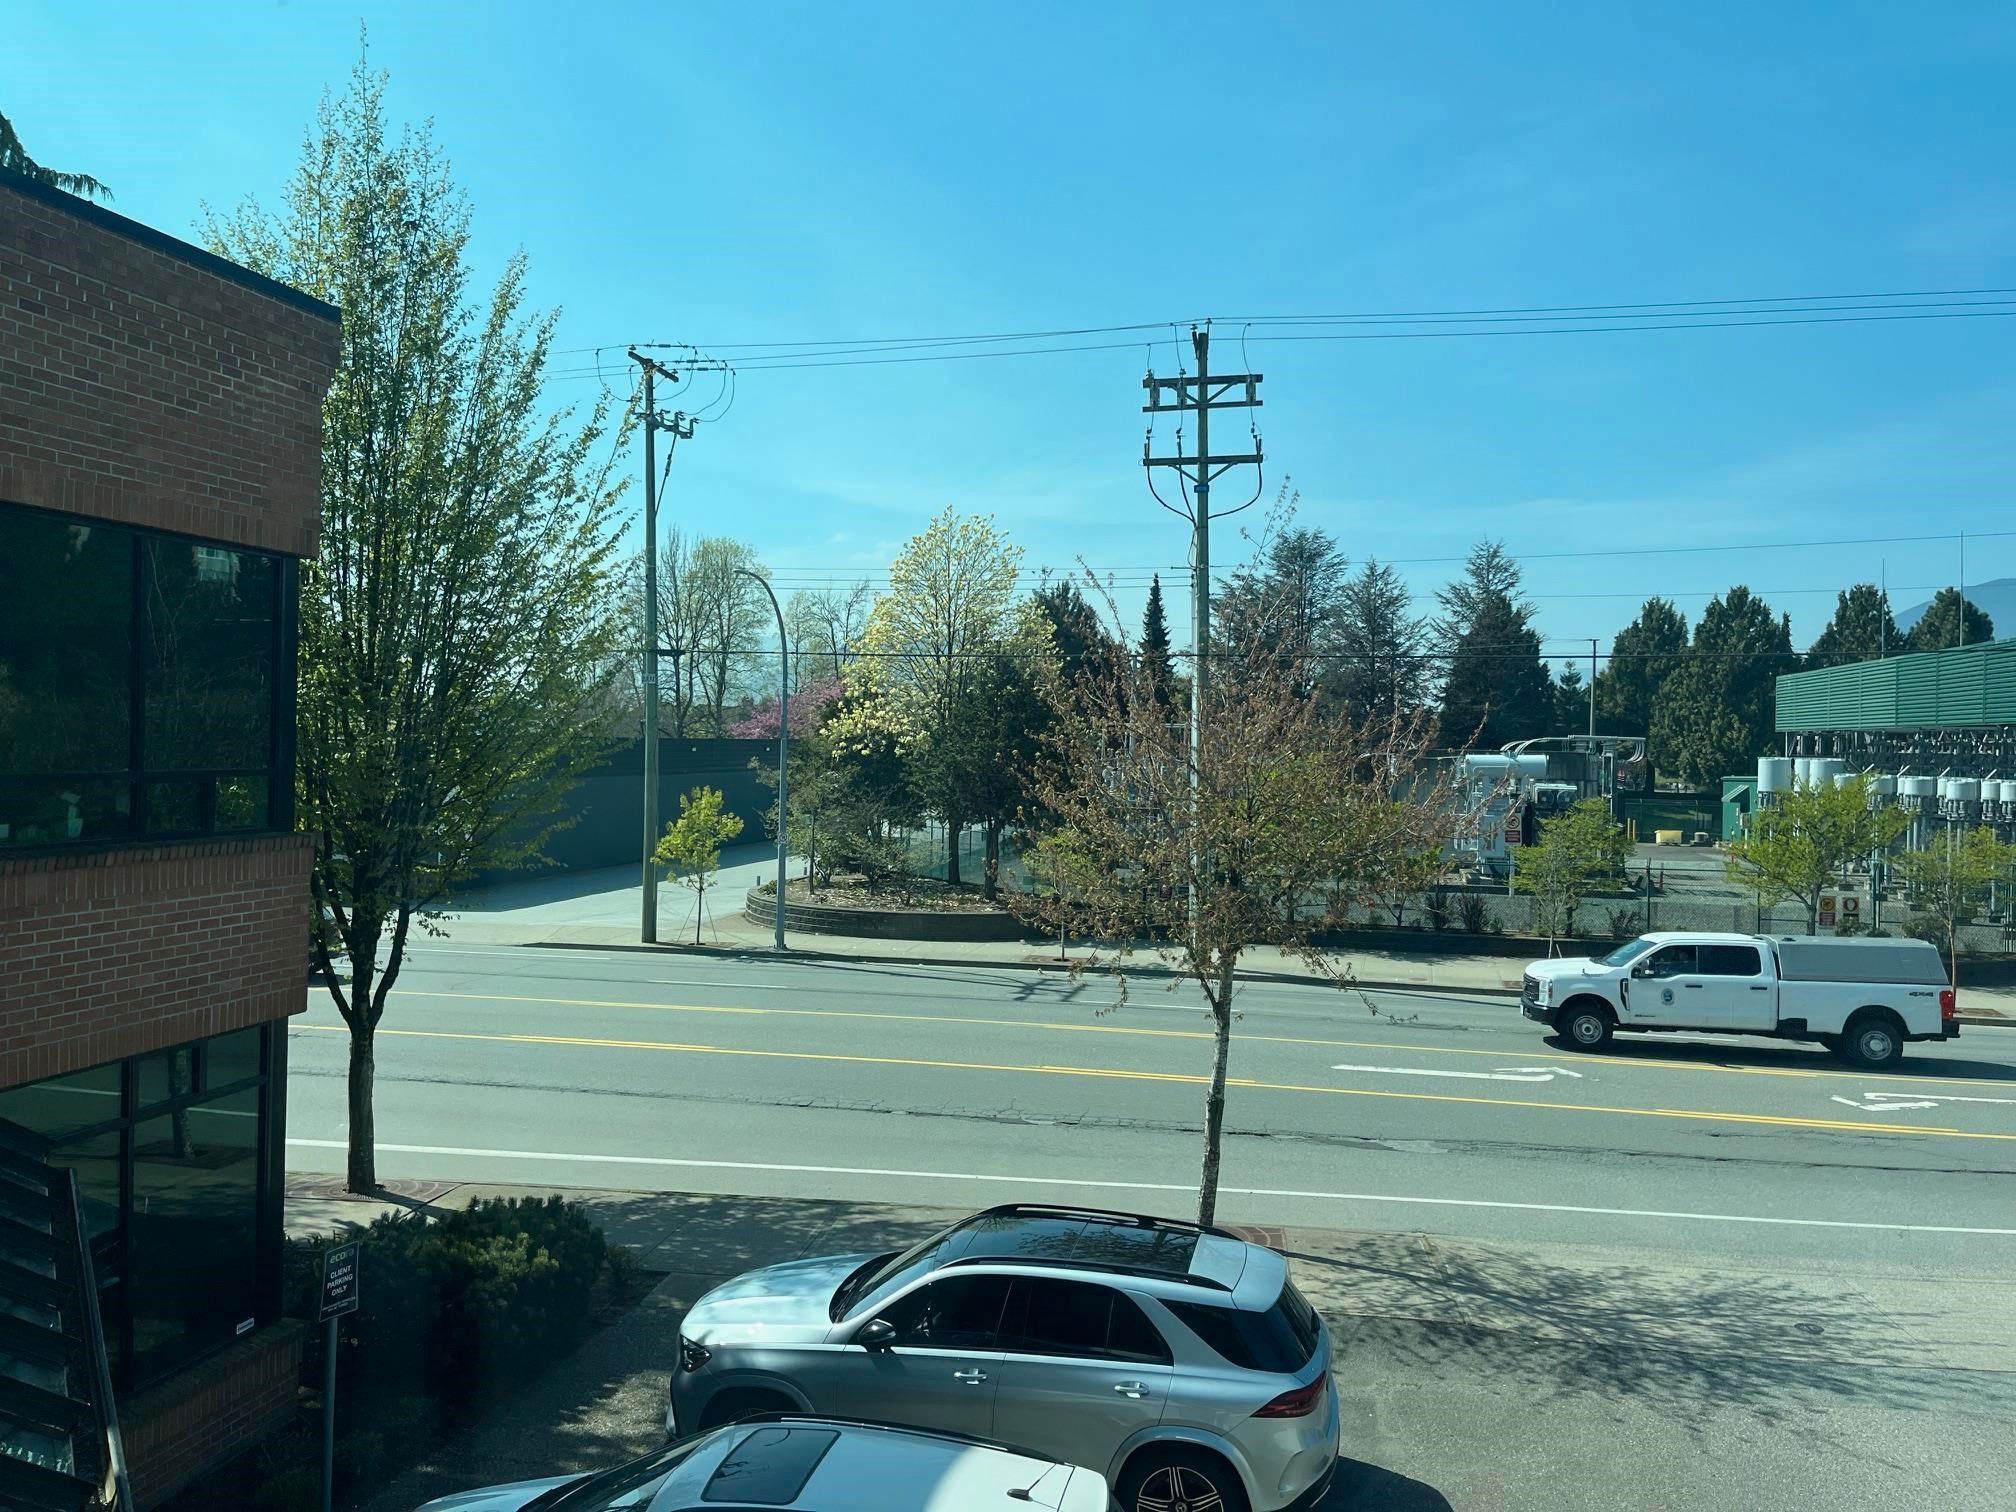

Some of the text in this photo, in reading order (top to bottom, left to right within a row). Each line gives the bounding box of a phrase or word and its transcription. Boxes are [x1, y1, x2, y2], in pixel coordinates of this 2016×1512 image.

[330, 1265, 352, 1279] CLIENT
[327, 1273, 353, 1289] PARKING
[331, 1284, 347, 1296] ONLY
